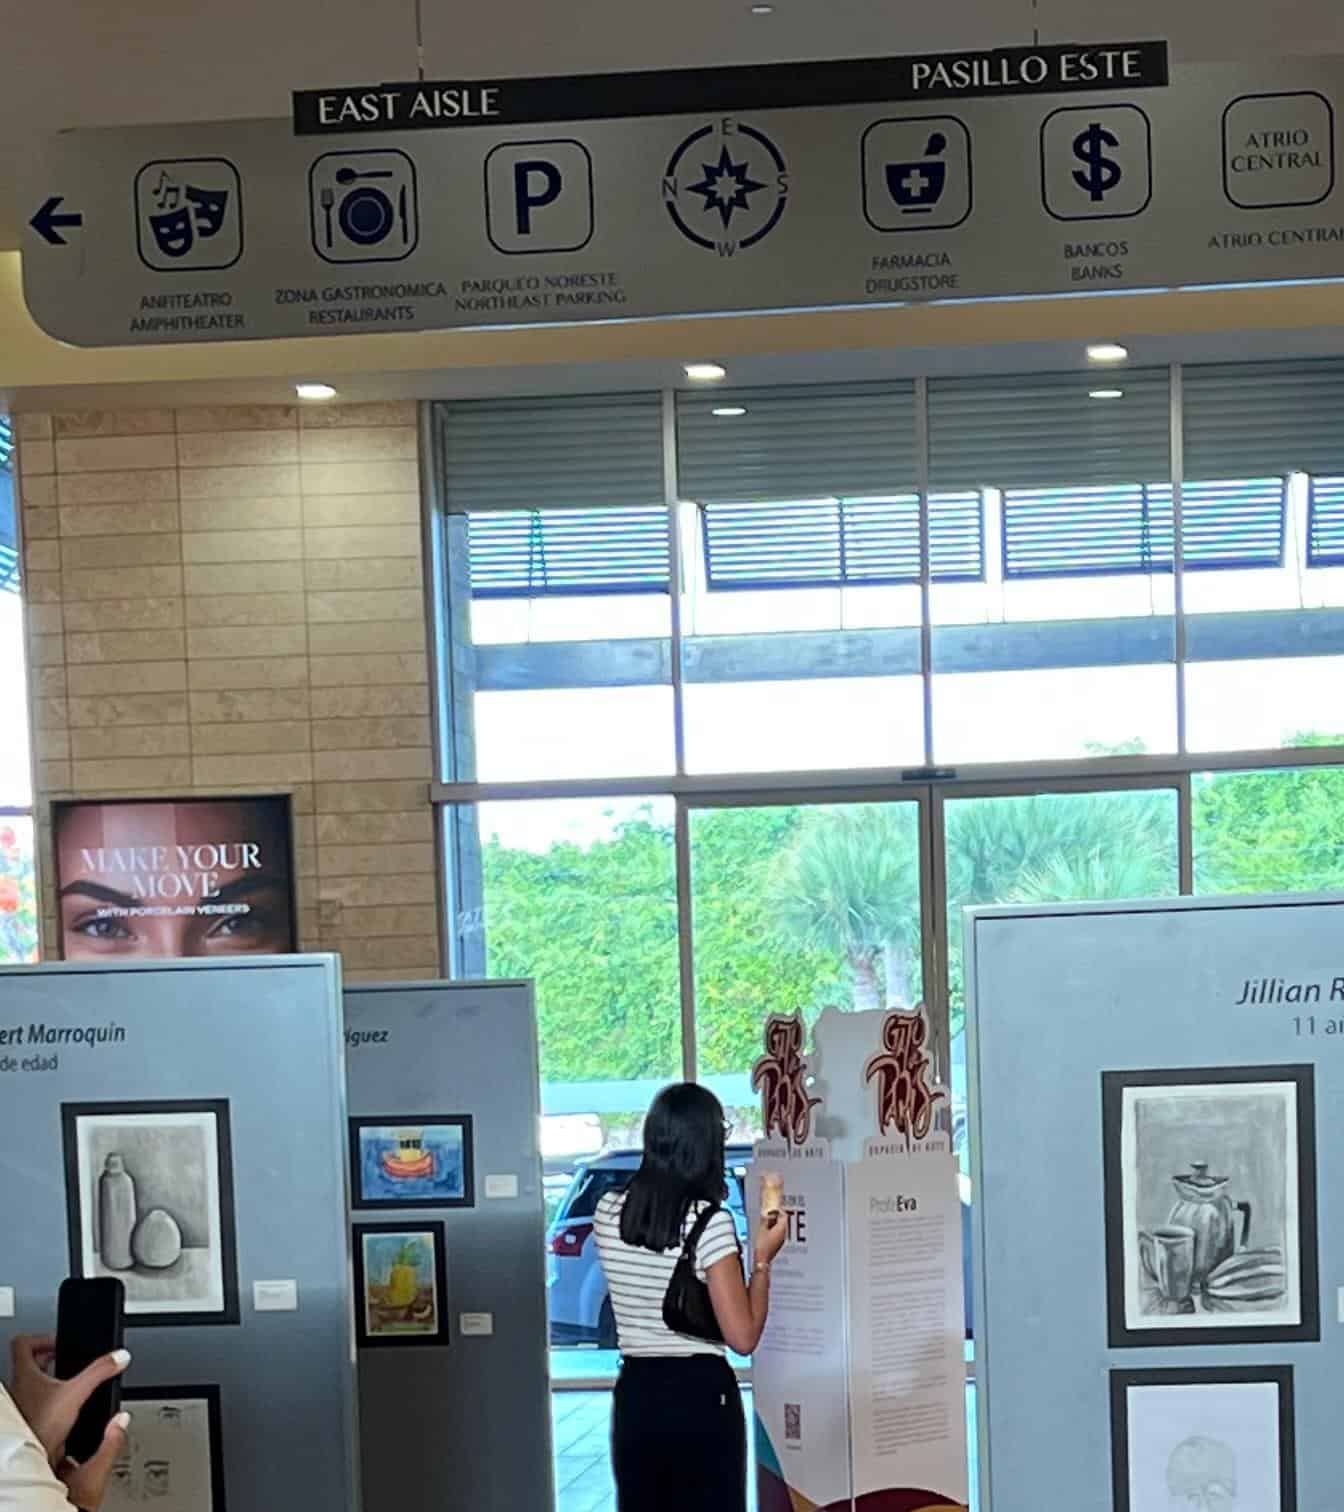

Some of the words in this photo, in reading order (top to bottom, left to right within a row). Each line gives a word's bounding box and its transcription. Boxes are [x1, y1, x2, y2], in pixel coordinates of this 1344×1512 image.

[911, 55, 1049, 91] PASILLO
[1059, 50, 1142, 82] ESTE
[318, 92, 401, 125] EAST
[408, 87, 501, 119] AISLE
[1244, 128, 1310, 149] ATRIO
[1231, 151, 1325, 173] CENTRAL
[512, 160, 562, 235] P
[1063, 241, 1128, 260] BANCOS
[1207, 231, 1263, 249] ATRIO
[870, 252, 951, 271] FARMACIA
[1071, 263, 1123, 282] BANKS
[274, 287, 318, 305] ZONA
[321, 281, 447, 303] GASTRONOMICA
[460, 276, 541, 294] PARQUEO
[544, 271, 618, 290] NORESTE
[865, 274, 960, 295] DRUGSTORE
[139, 291, 233, 311] ANFITEATRO
[454, 292, 550, 312] NORTHEAST
[554, 288, 627, 306] PARKING
[129, 313, 246, 334] AMPHITHEATER
[308, 304, 416, 326] RESTAURANTS
[80, 847, 170, 874] MAKE
[174, 842, 263, 871] YOUR
[130, 871, 221, 899] MOVE
[1235, 978, 1321, 1006] Jillian
[1292, 1015, 1316, 1036] 11
[0, 1055, 18, 1073] de
[21, 1053, 59, 1072] edad
